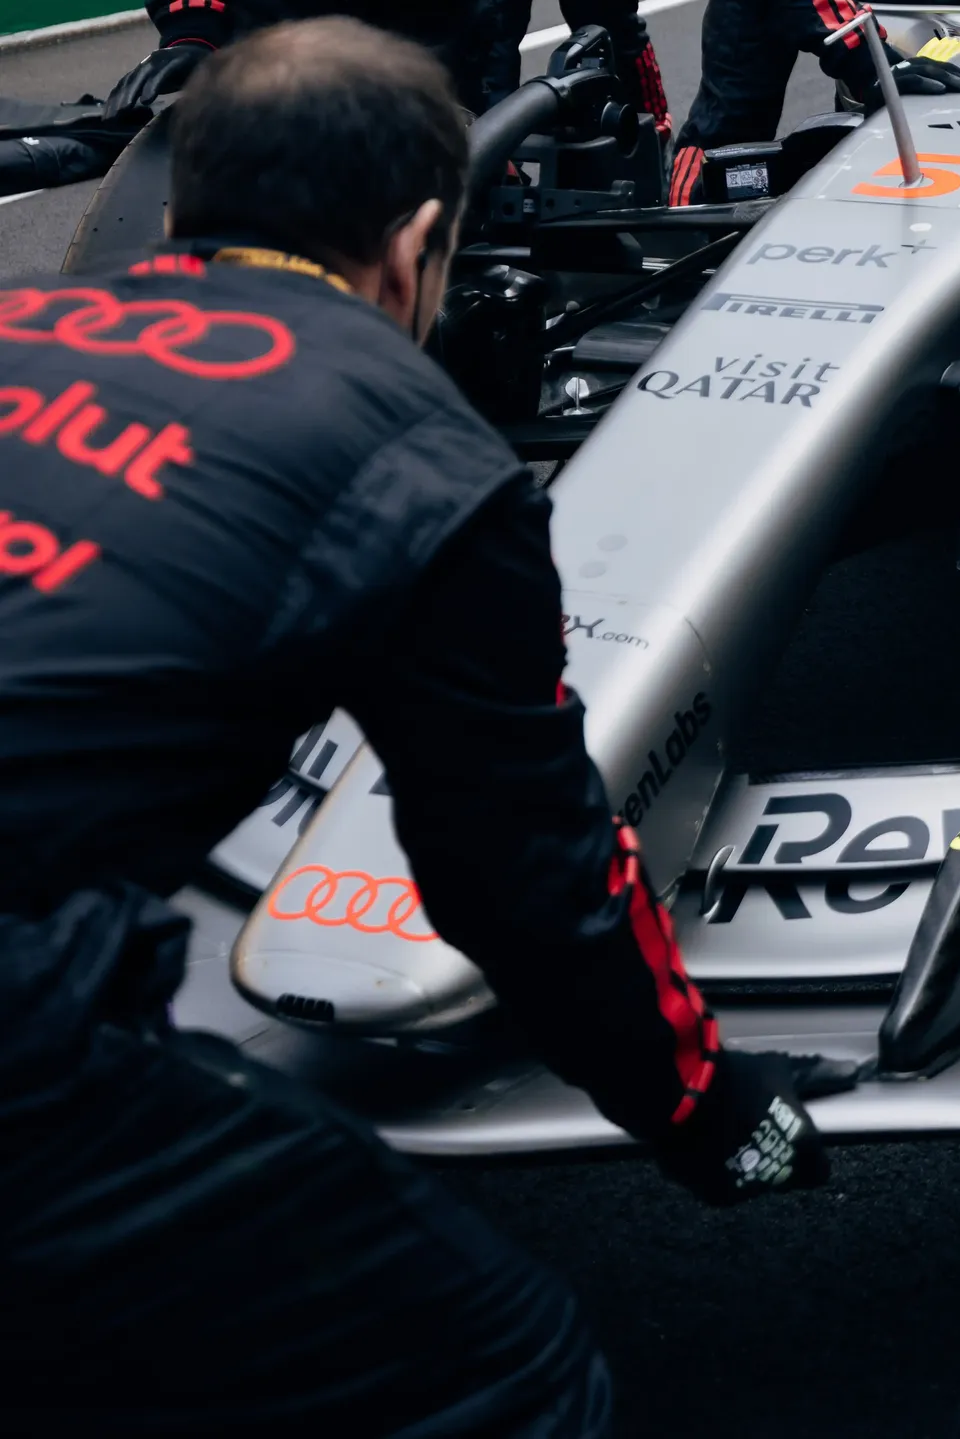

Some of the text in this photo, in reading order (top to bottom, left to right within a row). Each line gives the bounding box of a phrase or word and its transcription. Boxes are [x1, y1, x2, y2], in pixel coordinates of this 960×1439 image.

[701, 293, 884, 325] PIRELLI
[713, 353, 840, 383] visit
[636, 370, 821, 408] QATAR
[616, 691, 712, 828] enLabs
